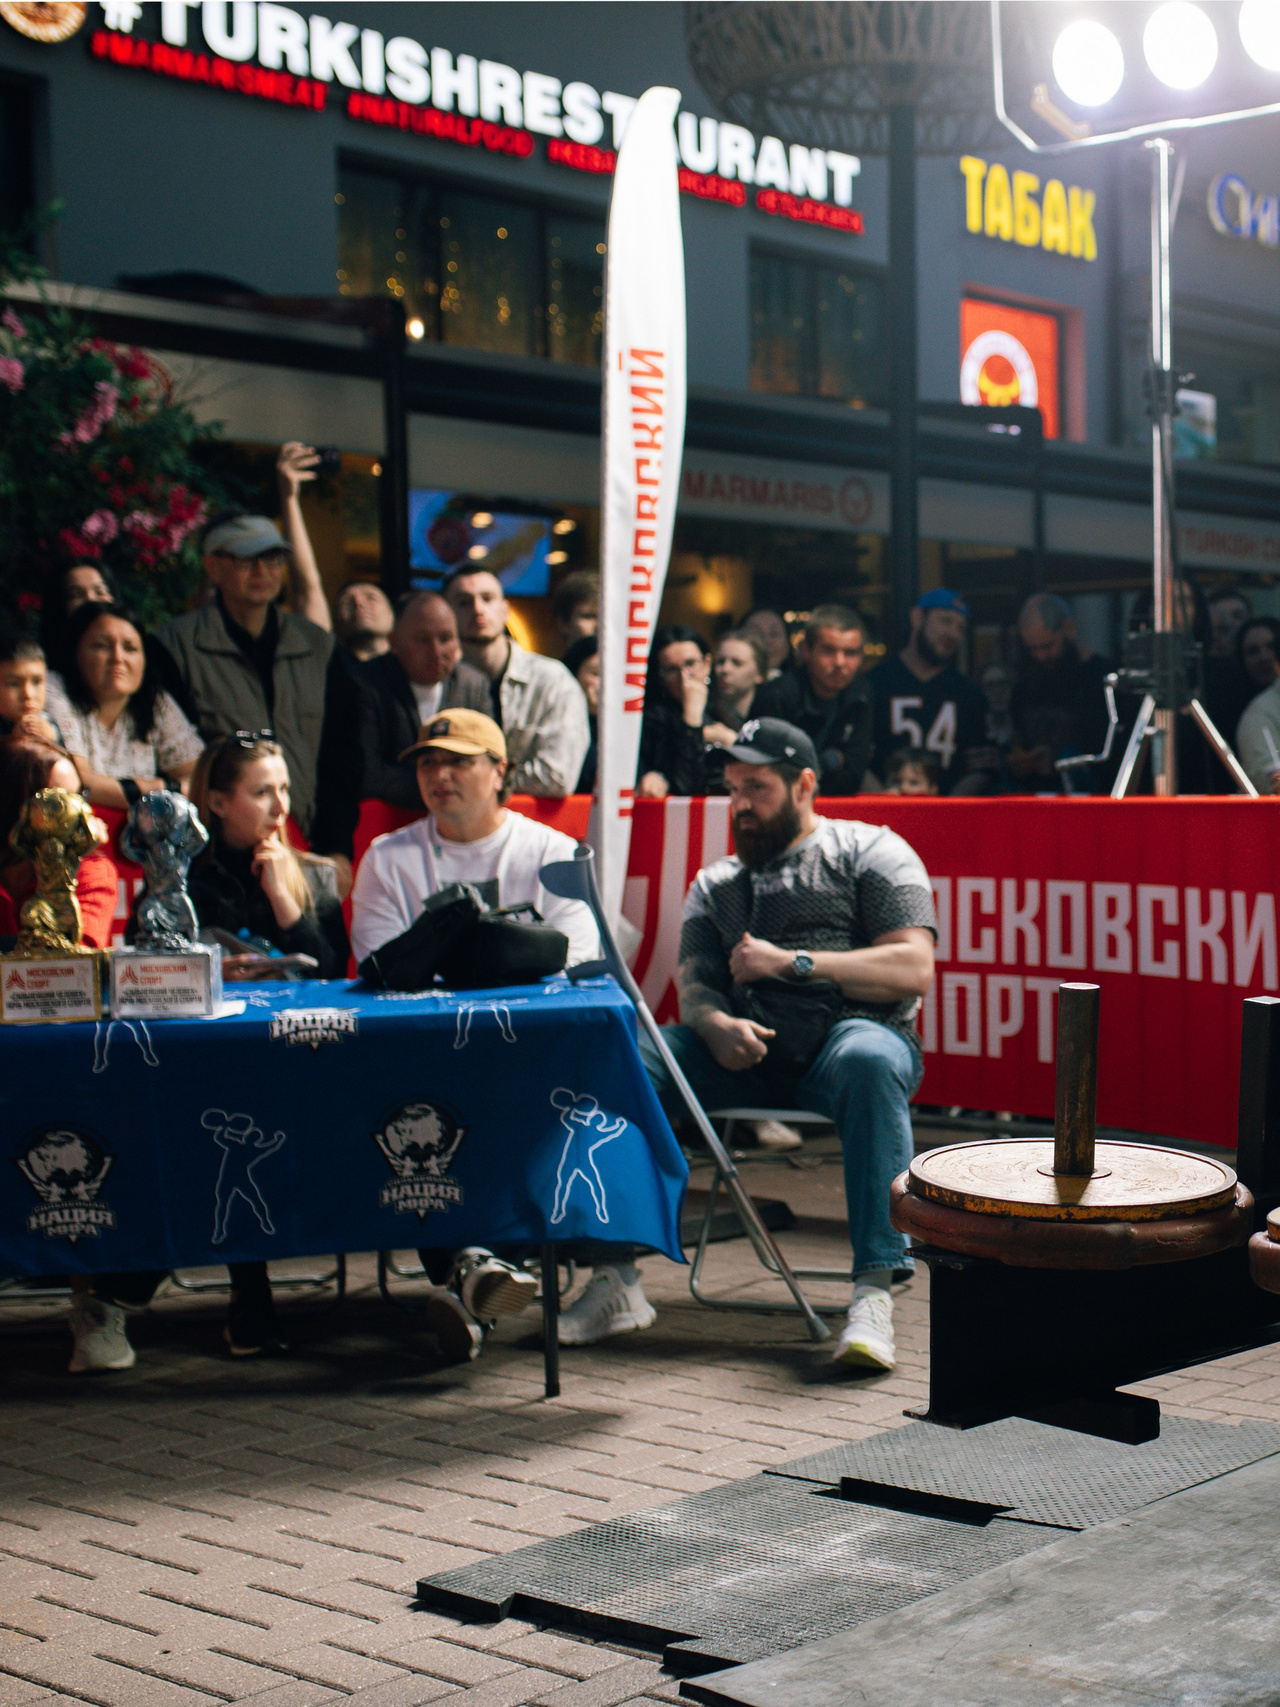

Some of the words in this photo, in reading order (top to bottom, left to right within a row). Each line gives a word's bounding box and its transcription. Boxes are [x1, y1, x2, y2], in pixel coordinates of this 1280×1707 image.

[99, 1, 861, 207] #TURKISHRESTURANT
[960, 156, 1098, 261] ТАБАК
[891, 697, 957, 769] 54
[272, 1014, 357, 1038] НАЦИЯ
[922, 971, 1066, 1064] ОРТ
[381, 1183, 460, 1204] НАЦИЯ
[397, 1197, 446, 1211] МИРА
[28, 1208, 114, 1230] НАЦИЯ
[47, 1224, 98, 1236] МИРА
